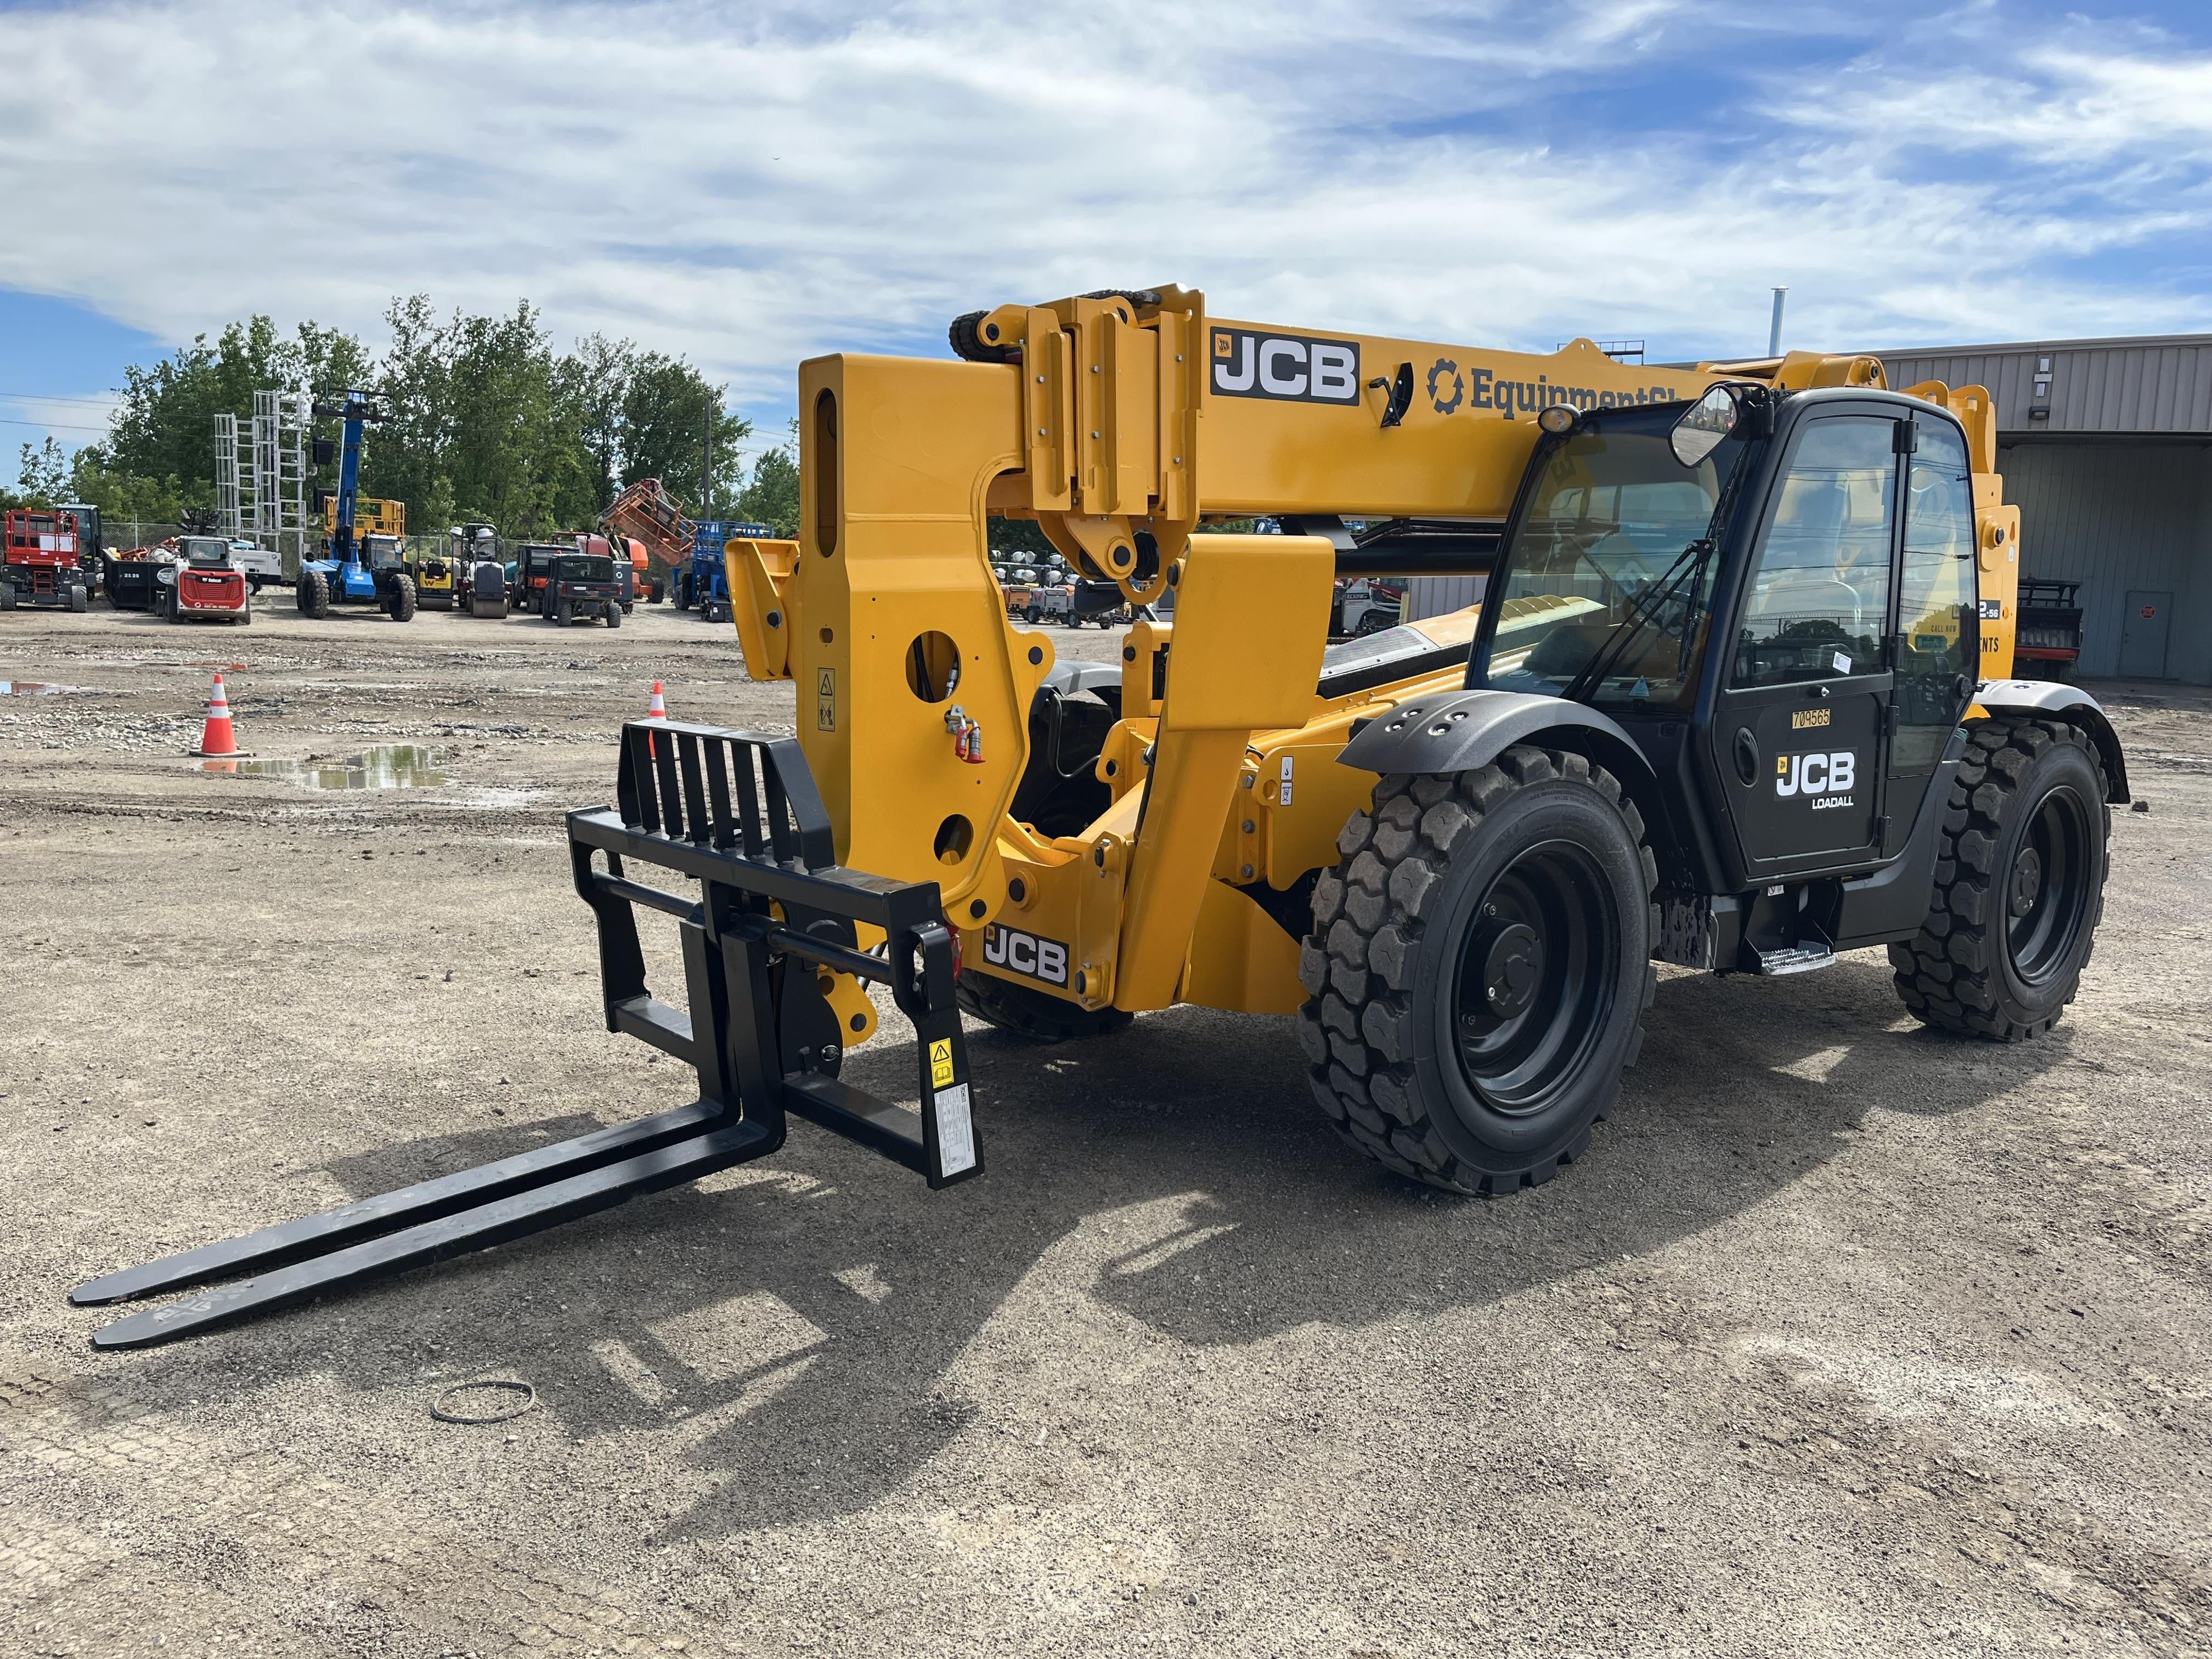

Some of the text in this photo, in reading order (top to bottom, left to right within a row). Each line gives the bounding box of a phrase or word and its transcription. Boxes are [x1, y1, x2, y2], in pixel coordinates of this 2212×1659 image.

[1215, 336, 1356, 399] JCB
[1931, 624, 1943, 633] CALL
[1979, 637, 1999, 653] NTS
[1794, 709, 1829, 727] 709565
[1776, 752, 1855, 796] JCB
[1812, 795, 1854, 810] LOADALL
[985, 928, 1066, 983] JCB
